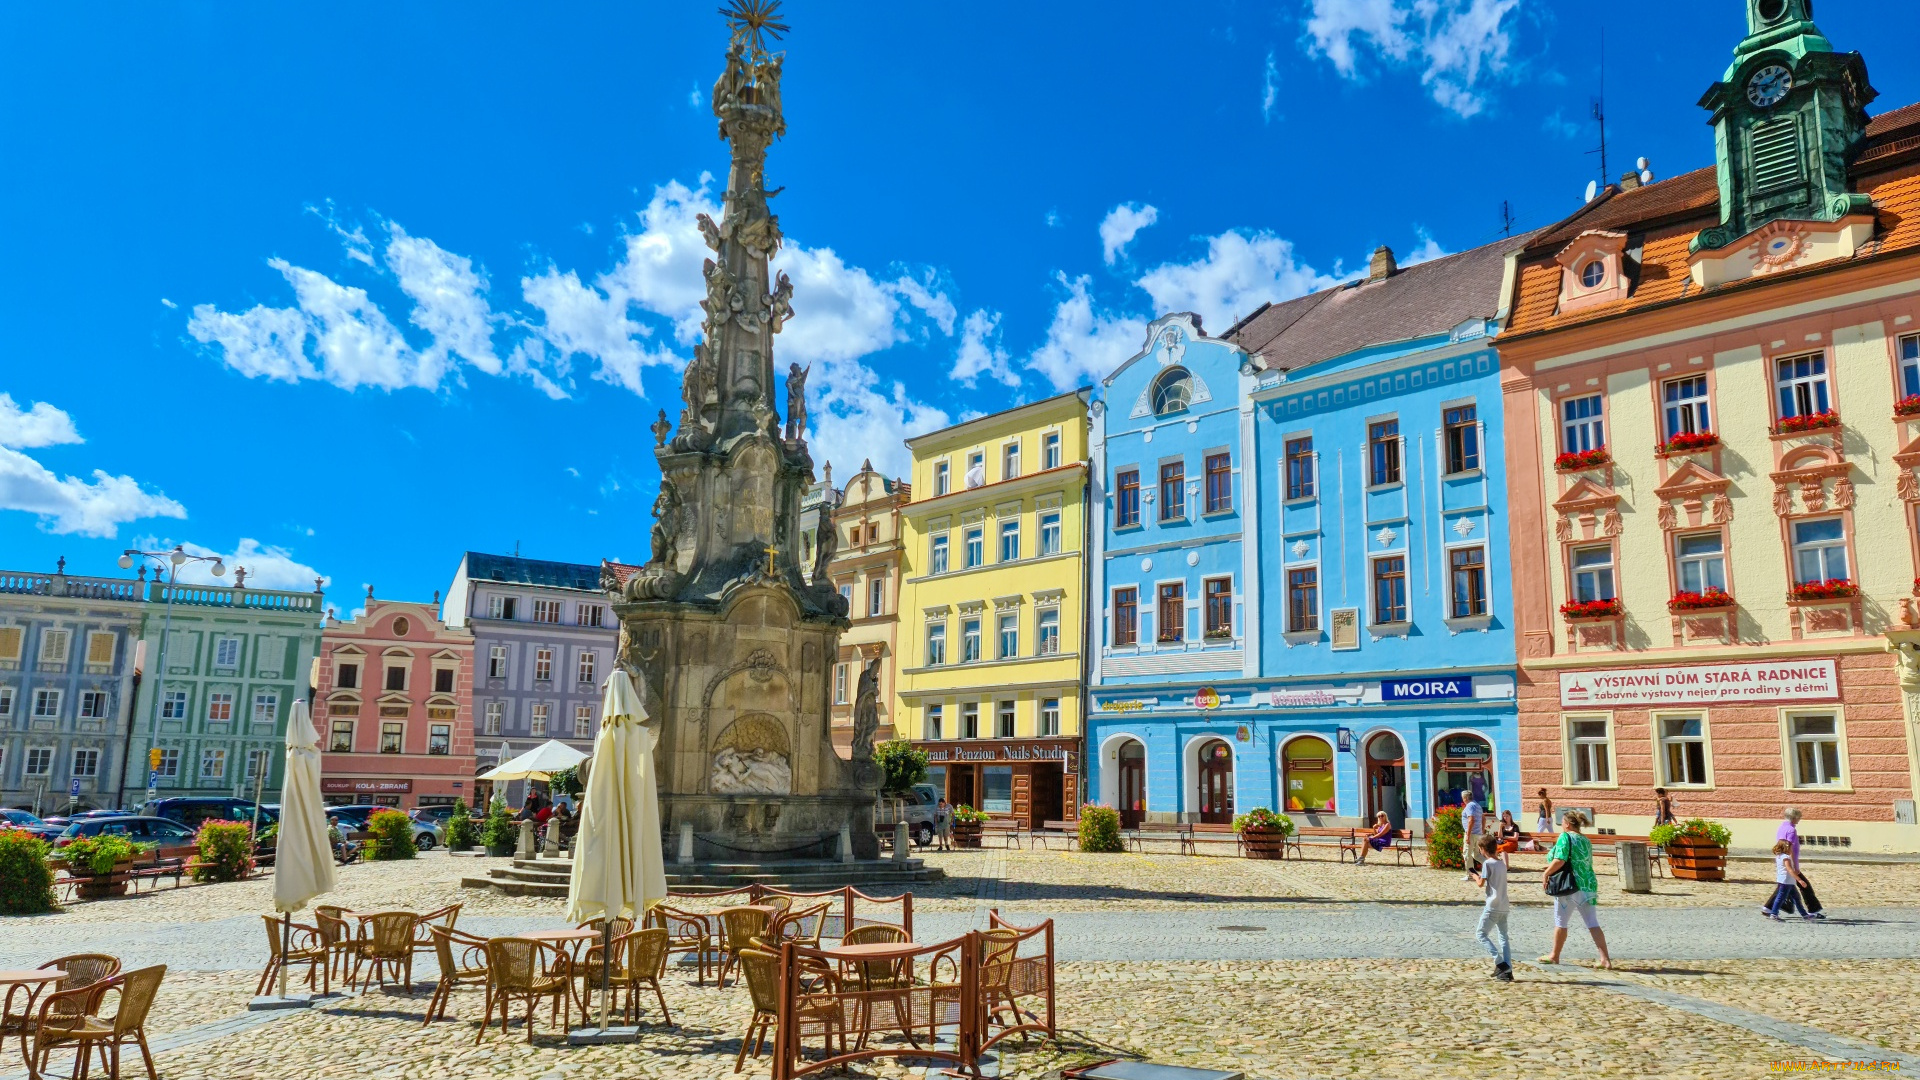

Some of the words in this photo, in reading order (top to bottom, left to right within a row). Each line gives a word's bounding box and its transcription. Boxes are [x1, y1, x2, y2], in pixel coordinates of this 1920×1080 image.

[1593, 672, 1660, 687] VÝSTAVNÍ
[1665, 670, 1699, 685] DŮM
[1704, 668, 1752, 684] STARÁ
[1757, 667, 1827, 681] RADNICE
[1394, 681, 1459, 697] MOIRA
[1594, 690, 1638, 700] zábavné
[1642, 689, 1684, 700] výstavy
[1687, 687, 1717, 698] nejen
[1720, 687, 1740, 698] pro
[1743, 684, 1781, 696] rodiny
[1785, 685, 1791, 693] s
[1794, 682, 1829, 693] dětmi
[1197, 695, 1217, 704] teta
[1272, 690, 1334, 704] kosmetika
[1101, 699, 1143, 713] drogerie
[955, 746, 996, 760] Penzion
[1003, 745, 1030, 760] Nails
